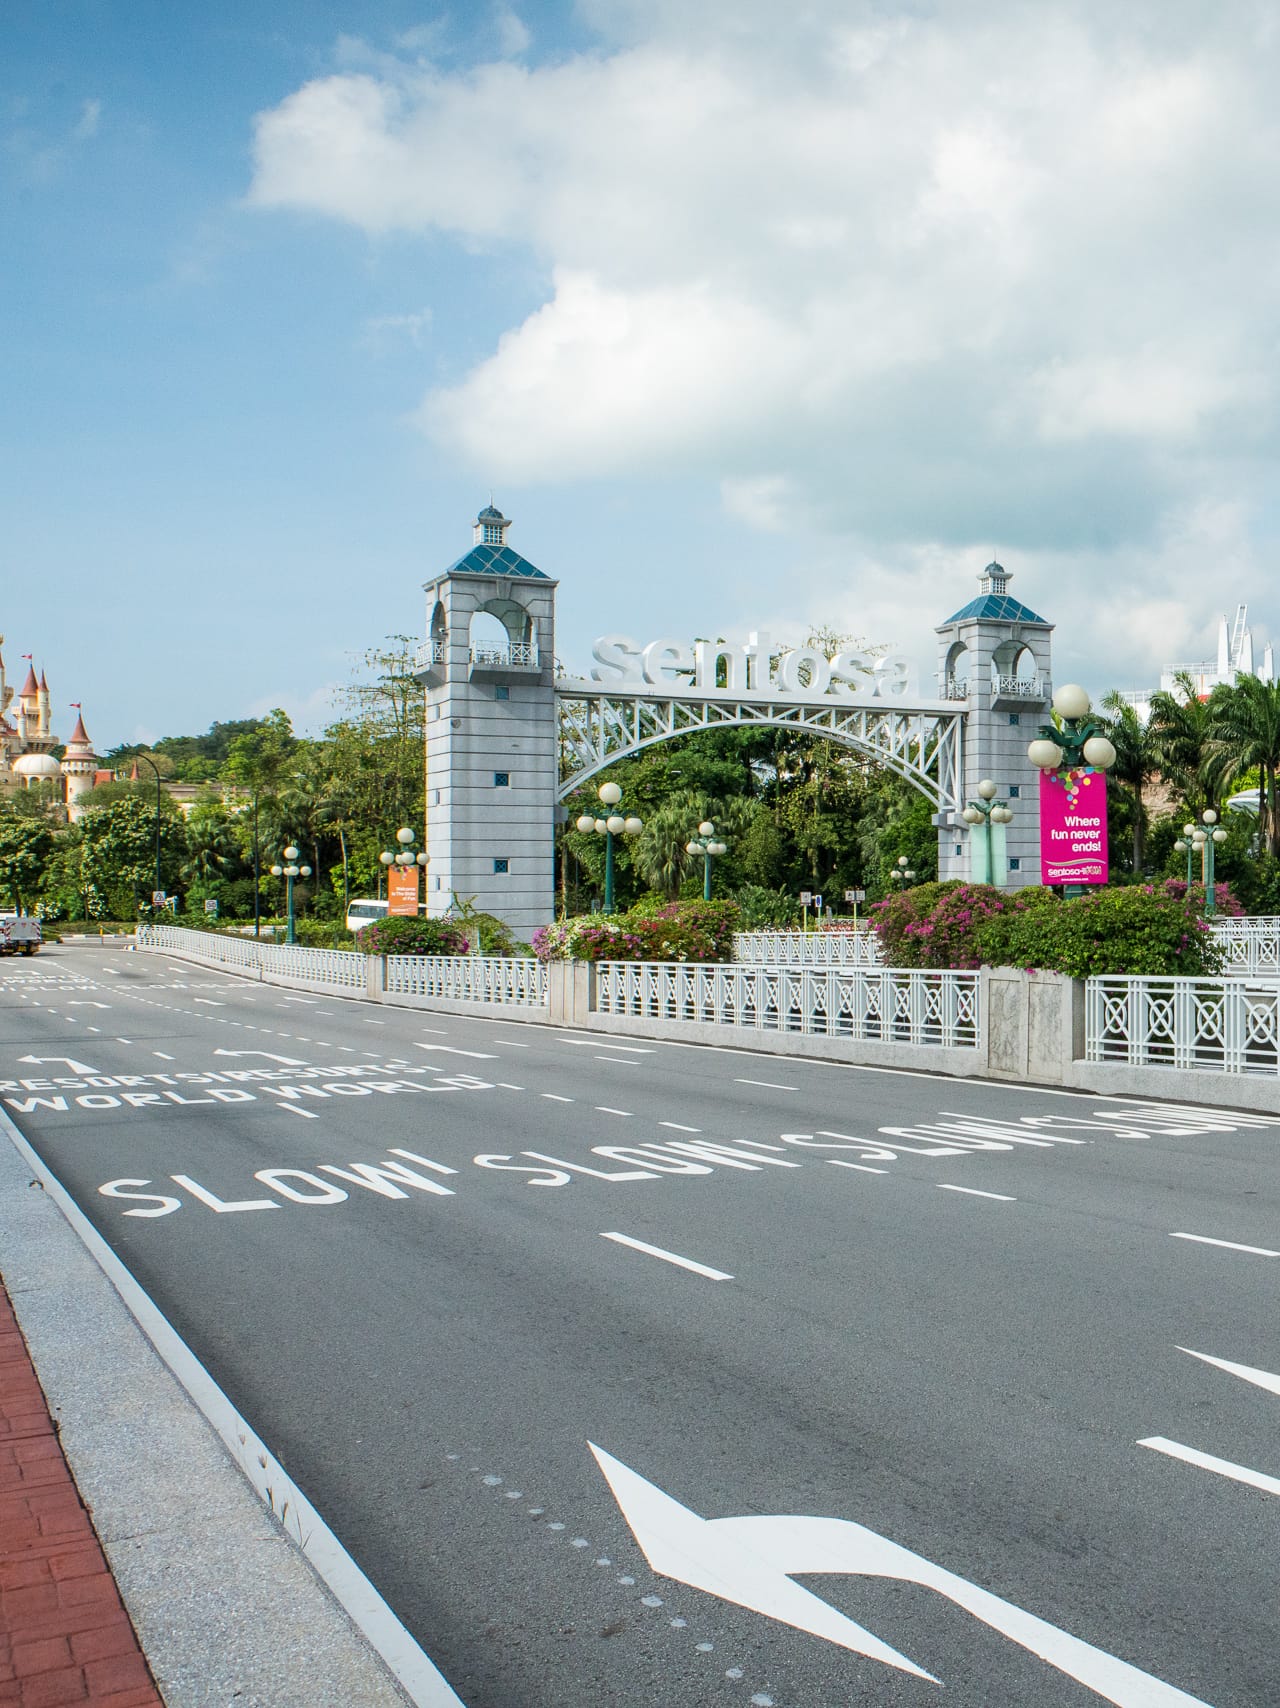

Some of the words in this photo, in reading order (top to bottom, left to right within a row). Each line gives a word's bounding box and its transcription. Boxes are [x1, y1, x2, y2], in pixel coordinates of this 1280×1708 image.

[591, 631, 918, 698] sentosa
[1064, 816, 1100, 827] Where
[1051, 829, 1069, 840] fun
[1070, 830, 1101, 839] never
[1072, 841, 1101, 852] ends!
[6, 1088, 257, 1113] WORLD
[259, 1078, 497, 1100] WORLD
[780, 1120, 1087, 1161] SLOW
[473, 1140, 802, 1187] SLOW
[99, 1161, 457, 1218] SLOW
